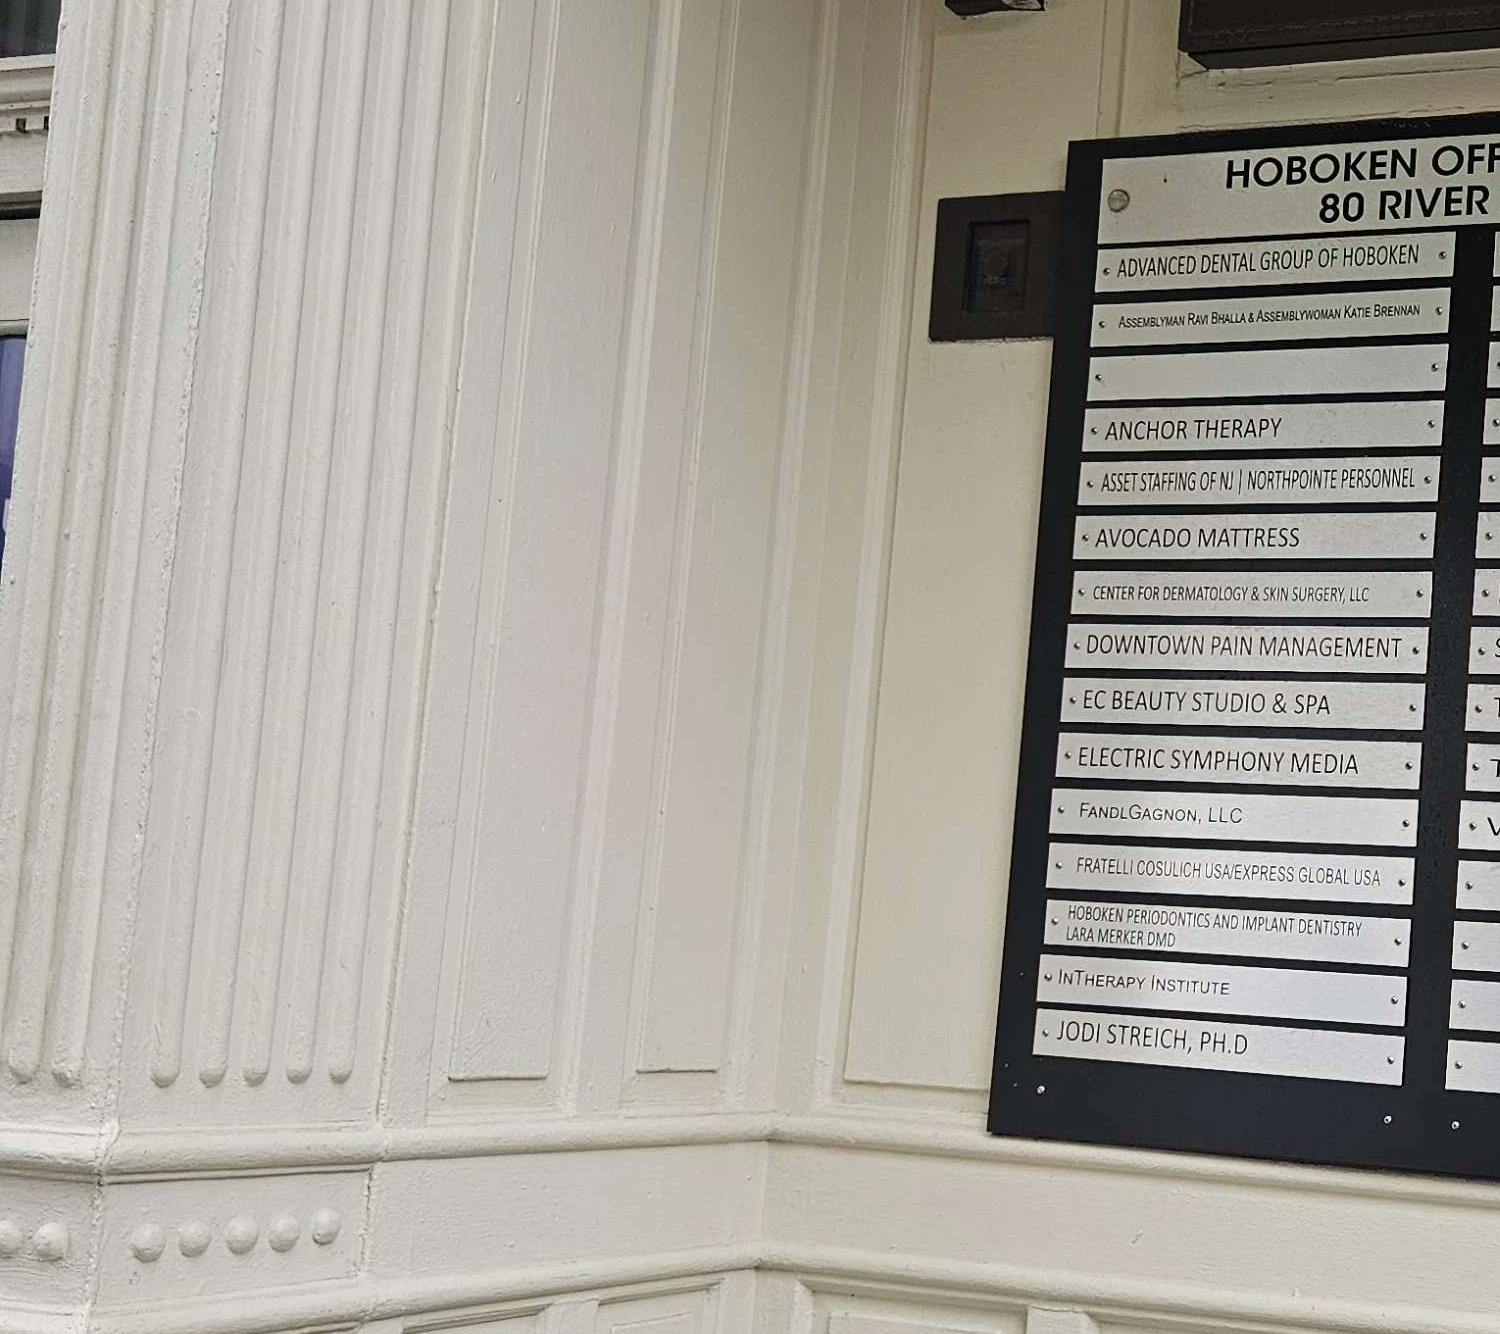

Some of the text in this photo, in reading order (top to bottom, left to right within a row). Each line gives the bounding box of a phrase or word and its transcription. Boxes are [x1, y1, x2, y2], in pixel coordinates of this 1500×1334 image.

[1225, 146, 1418, 189] HOBOKEN
[1318, 190, 1365, 224] 80
[1377, 184, 1490, 221] RIVER
[1115, 242, 1419, 278] ADVANCED DENTAL GROUP OF HOBOKEN
[1246, 311, 1255, 324] &
[1103, 416, 1283, 441] ANCHOR THERAPY
[1099, 471, 1138, 493] ASSET
[1139, 470, 1197, 493] STAFFING
[1198, 470, 1218, 492] OF
[1218, 469, 1234, 491] NJ
[1246, 468, 1338, 491] NORTHPOINTE
[1340, 466, 1416, 490] PERSONNEL
[1093, 526, 1300, 548] AVOCADO MATTRESS
[1091, 584, 1370, 605] CENTER FOR DERMATOLOGY & SKIN SURGERY, LLC
[1085, 633, 1403, 658] DOWNTOWN PAIN MANAGEMENT
[1082, 688, 1330, 715] EC BEAUTY STUDIO & SPA
[1077, 745, 1359, 775] ELECTRIC SYMPHONY MEDIA
[1207, 805, 1243, 824] LLC
[1075, 855, 1381, 887] FRATELLI COSULICH USA/EXPRESS GLOBAL USA
[1066, 903, 1363, 937] HOBOKEN PERIODONTICS AND IMPLANT DENTISTRY
[1065, 926, 1176, 948] LARA MERKER DMD
[1055, 1019, 1248, 1055] JODI STREICH, PH.D
